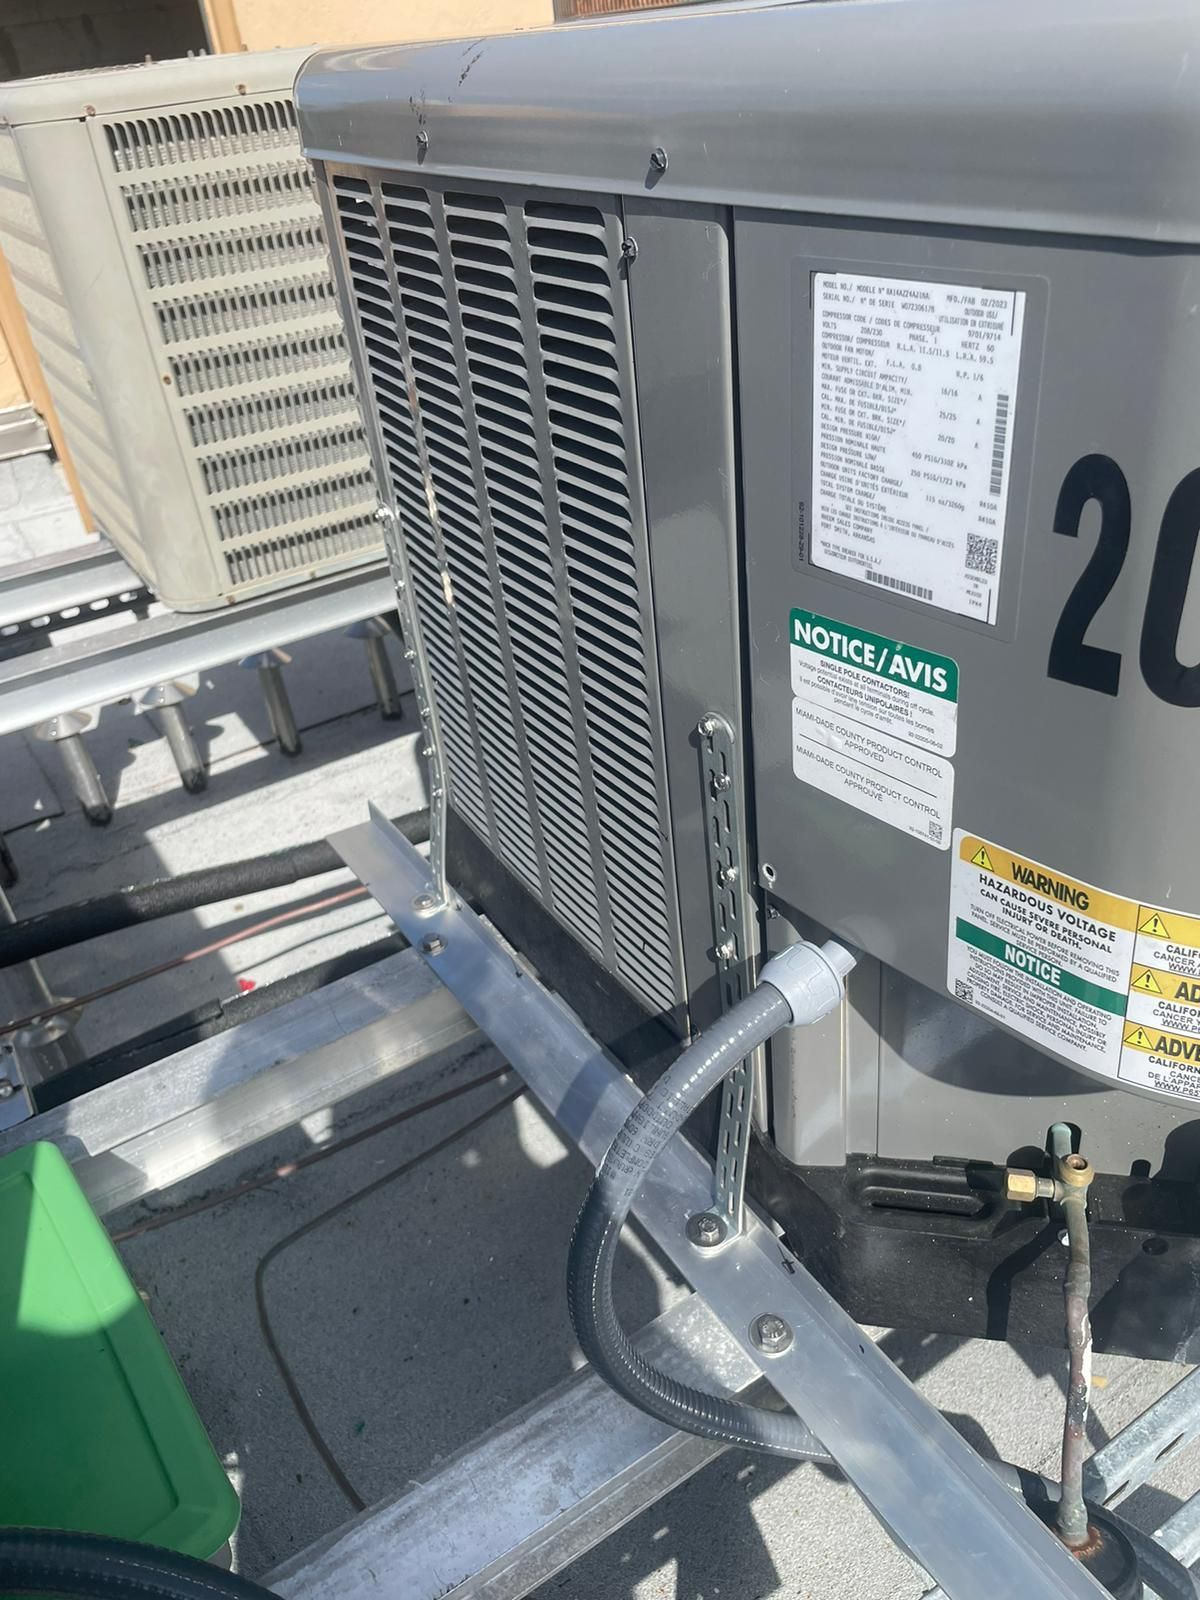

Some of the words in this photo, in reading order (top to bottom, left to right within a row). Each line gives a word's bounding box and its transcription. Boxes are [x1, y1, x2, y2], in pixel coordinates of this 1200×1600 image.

[823, 292, 840, 301] SERIAL
[980, 298, 1007, 308] 02/2023
[822, 310, 850, 320] COMPRESSOR
[853, 314, 865, 323] CODE
[874, 317, 890, 326] CODES
[893, 319, 900, 327] DE
[822, 320, 836, 329] VOLTS
[961, 340, 979, 350] HERTZ
[986, 343, 994, 352] 60
[817, 675, 863, 699] CONTACTEURS
[864, 692, 908, 716] UNIPOLAIRES
[820, 659, 842, 674] SINGLE
[843, 668, 859, 680] POLE
[861, 674, 909, 699] CONTACTORS!
[891, 695, 908, 708] during
[795, 707, 834, 731] MIAMI-DADE
[836, 725, 864, 744] COUNTY
[866, 738, 902, 761] PRODUCT
[904, 755, 942, 778] CONTROL
[844, 738, 883, 762] APPROVED
[796, 744, 833, 768] MIAMI-DADE
[835, 763, 863, 783] COUNTY
[866, 777, 900, 800] PRODUCT
[903, 795, 940, 819] CONTROL
[1010, 861, 1090, 912] WARNING
[979, 873, 1053, 915] HAZARDOUS
[1057, 907, 1115, 943] VOLTAGE
[980, 888, 997, 902] CAN
[1000, 897, 1027, 916] CAUSE
[1029, 910, 1060, 931] SEVERE
[1062, 925, 1112, 954] PERSONAL
[1002, 906, 1032, 926] INJURY
[1035, 922, 1047, 934] OR
[1050, 929, 1081, 950] DEATH.
[970, 903, 983, 914] TURN
[984, 910, 994, 919] OFF
[996, 915, 1024, 934] ELECTRICAL
[1026, 930, 1046, 945] POWER
[1047, 940, 1068, 955] BEFORE
[1069, 949, 1104, 971] REMOVING
[1105, 965, 1119, 977] THIS
[990, 919, 1009, 934] SERVICE
[1011, 930, 1026, 942] MUST
[1027, 938, 1034, 946] BE
[1035, 942, 1068, 963] PERFORMED
[1069, 958, 1076, 966] BY
[1083, 962, 1116, 985] QUALIFIED
[1016, 939, 1036, 954] SERVICE
[1154, 951, 1196, 967] CANCER
[1166, 944, 1200, 959] CALIF
[967, 945, 977, 955] YOU
[993, 958, 1013, 973] FOLLOW
[1014, 969, 1024, 979] THE
[1025, 975, 1062, 998] INSTALLATION
[1063, 994, 1075, 1005] AND
[1077, 1000, 1111, 1022] OPERATING
[975, 962, 982, 970] DO
[1030, 991, 1055, 1008] IMPROPER
[1004, 943, 1060, 986] NOTICE
[966, 976, 989, 993] PROPERTY
[1014, 1002, 1025, 1012] FOR
[1026, 1008, 1046, 1024] SERVICE
[1047, 1020, 1060, 1031] AND
[967, 970, 989, 987] CAUSING
[1002, 990, 1024, 1005] ELECTRIC
[1046, 1012, 1074, 1032] PERSONAL
[1075, 1027, 1095, 1042] INJURY
[1096, 1037, 1106, 1046] OR
[969, 953, 1004, 975] INSTRUCTIONS
[1006, 972, 1030, 989] PROVIDED
[1098, 1017, 1106, 1026] TO
[1002, 983, 1021, 997] SERVICE
[1023, 994, 1034, 1004] AND
[1008, 1005, 1034, 1024] QUALIFIED
[1035, 1020, 1056, 1036] SERVICE
[1152, 1009, 1194, 1024] CANCER
[1148, 1072, 1160, 1080] DE
